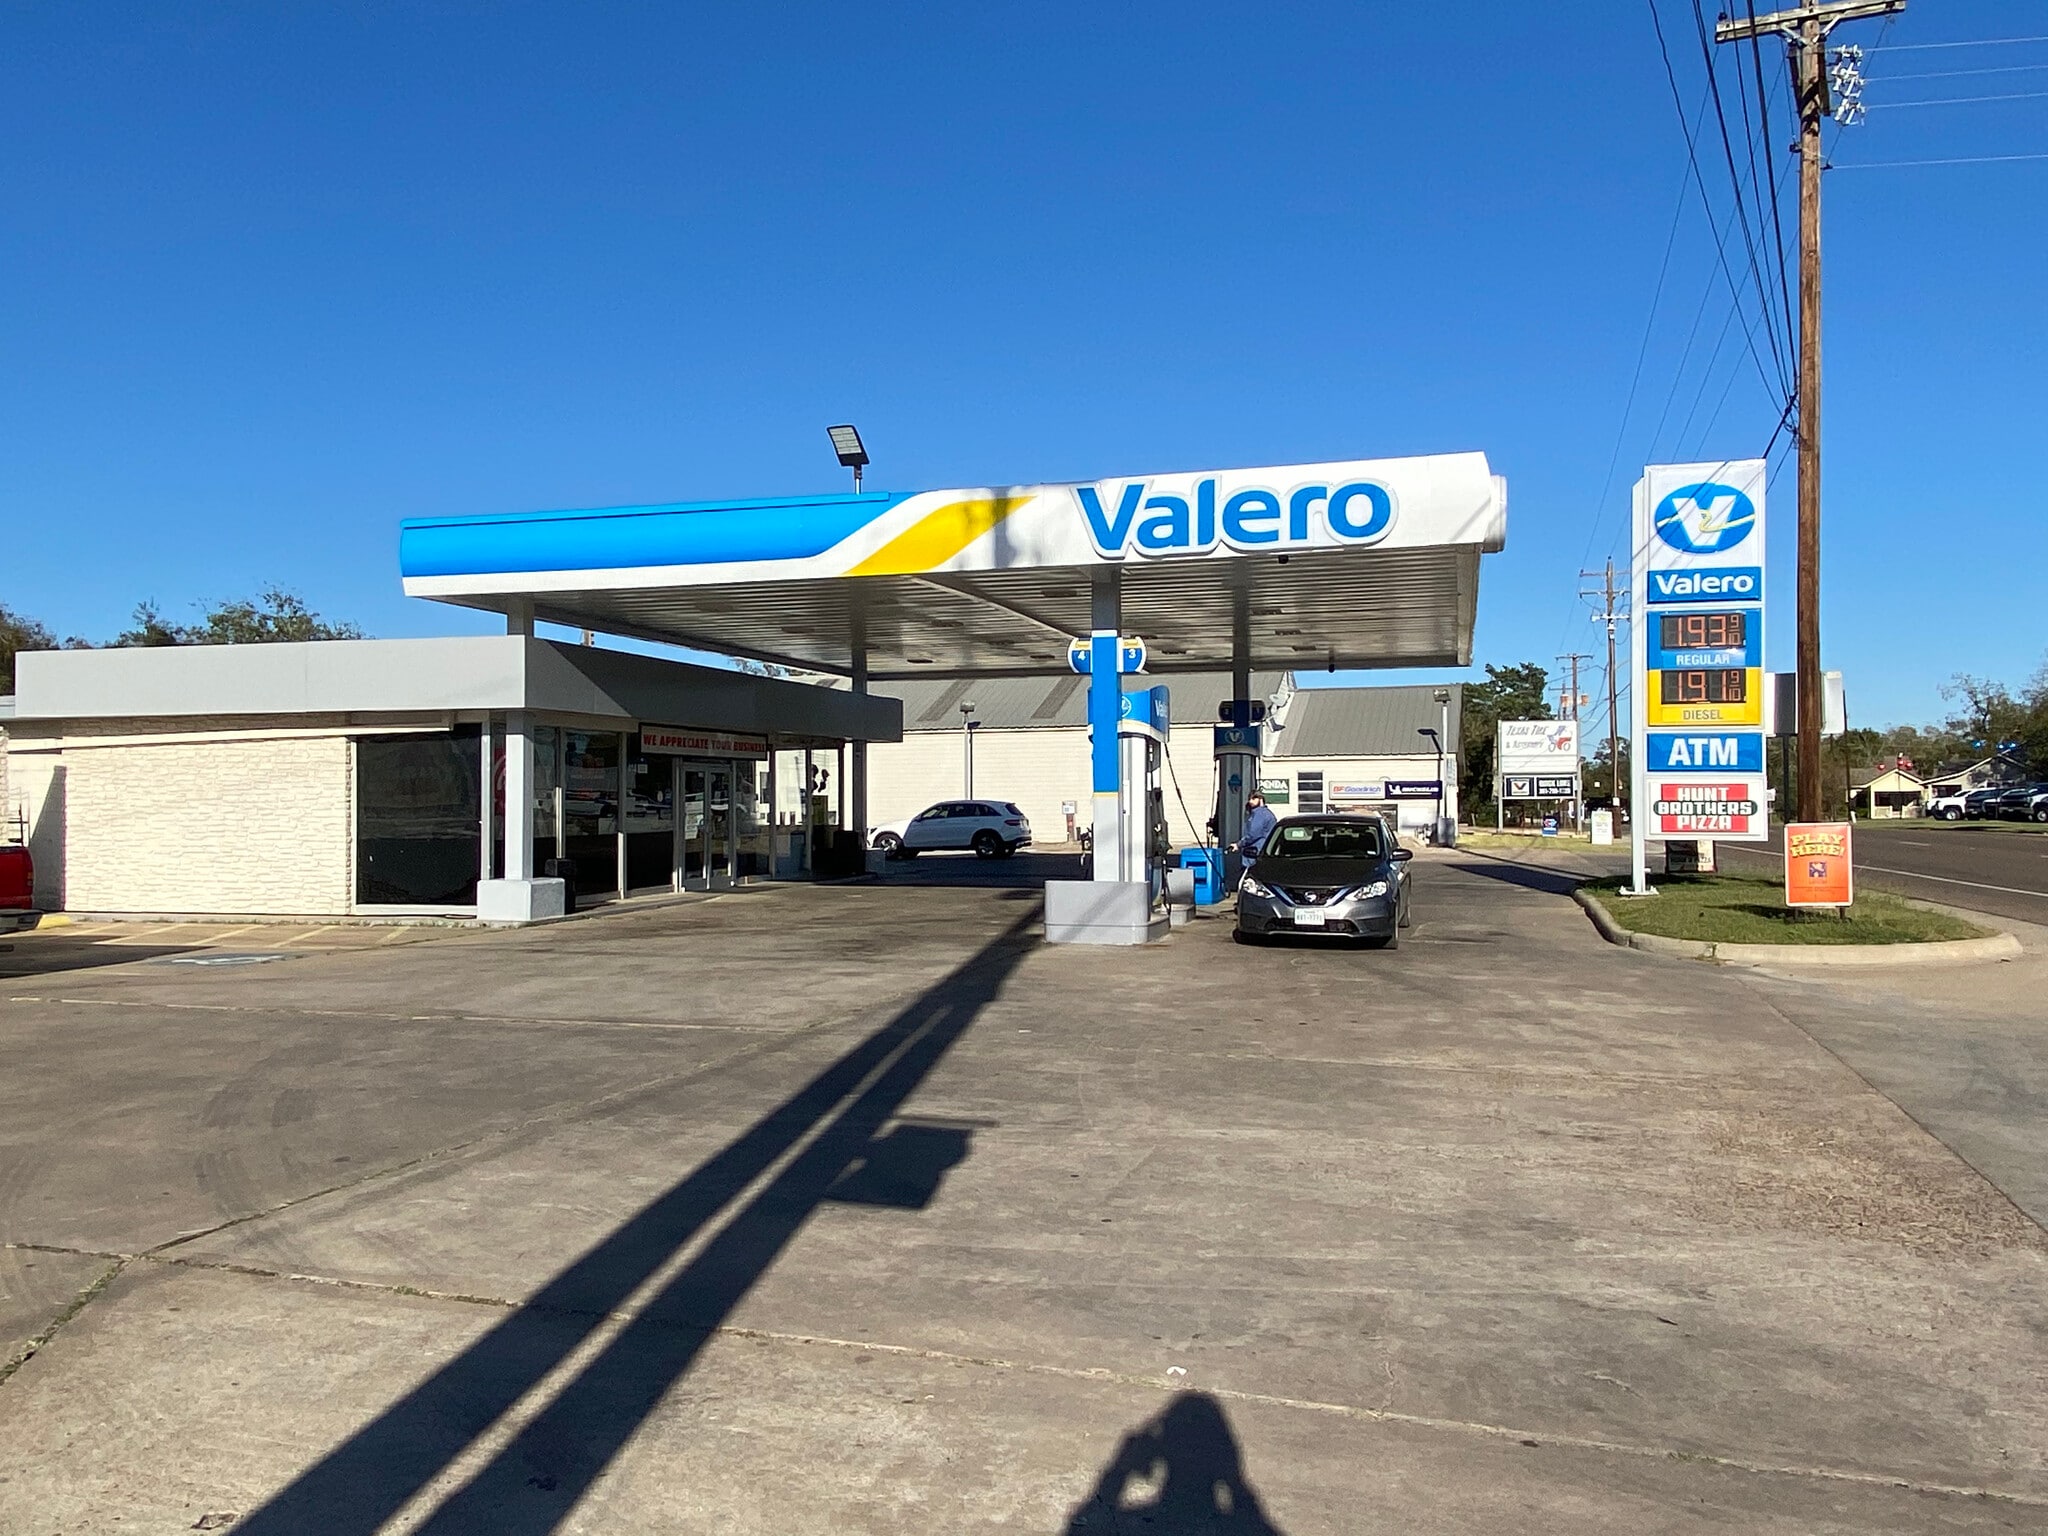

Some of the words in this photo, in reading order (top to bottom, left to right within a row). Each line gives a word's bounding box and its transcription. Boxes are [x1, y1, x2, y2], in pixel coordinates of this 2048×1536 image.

[1077, 479, 1390, 550] Valero
[1655, 573, 1754, 595] Valero
[1078, 651, 1086, 661] 4
[1128, 648, 1136, 659] 3
[1676, 654, 1730, 666] REGULAR
[1683, 710, 1723, 720] DIESEL
[643, 734, 657, 746] WE
[660, 735, 709, 750] APPRECIATE
[711, 740, 732, 750] YOUR
[1668, 738, 1738, 766] ATM
[1677, 787, 1730, 802] HUNT
[1657, 801, 1752, 815] BROTHERS
[1677, 815, 1732, 830] PIZZA
[1790, 833, 1845, 847] PLAY
[1790, 844, 1845, 858] HERE!
